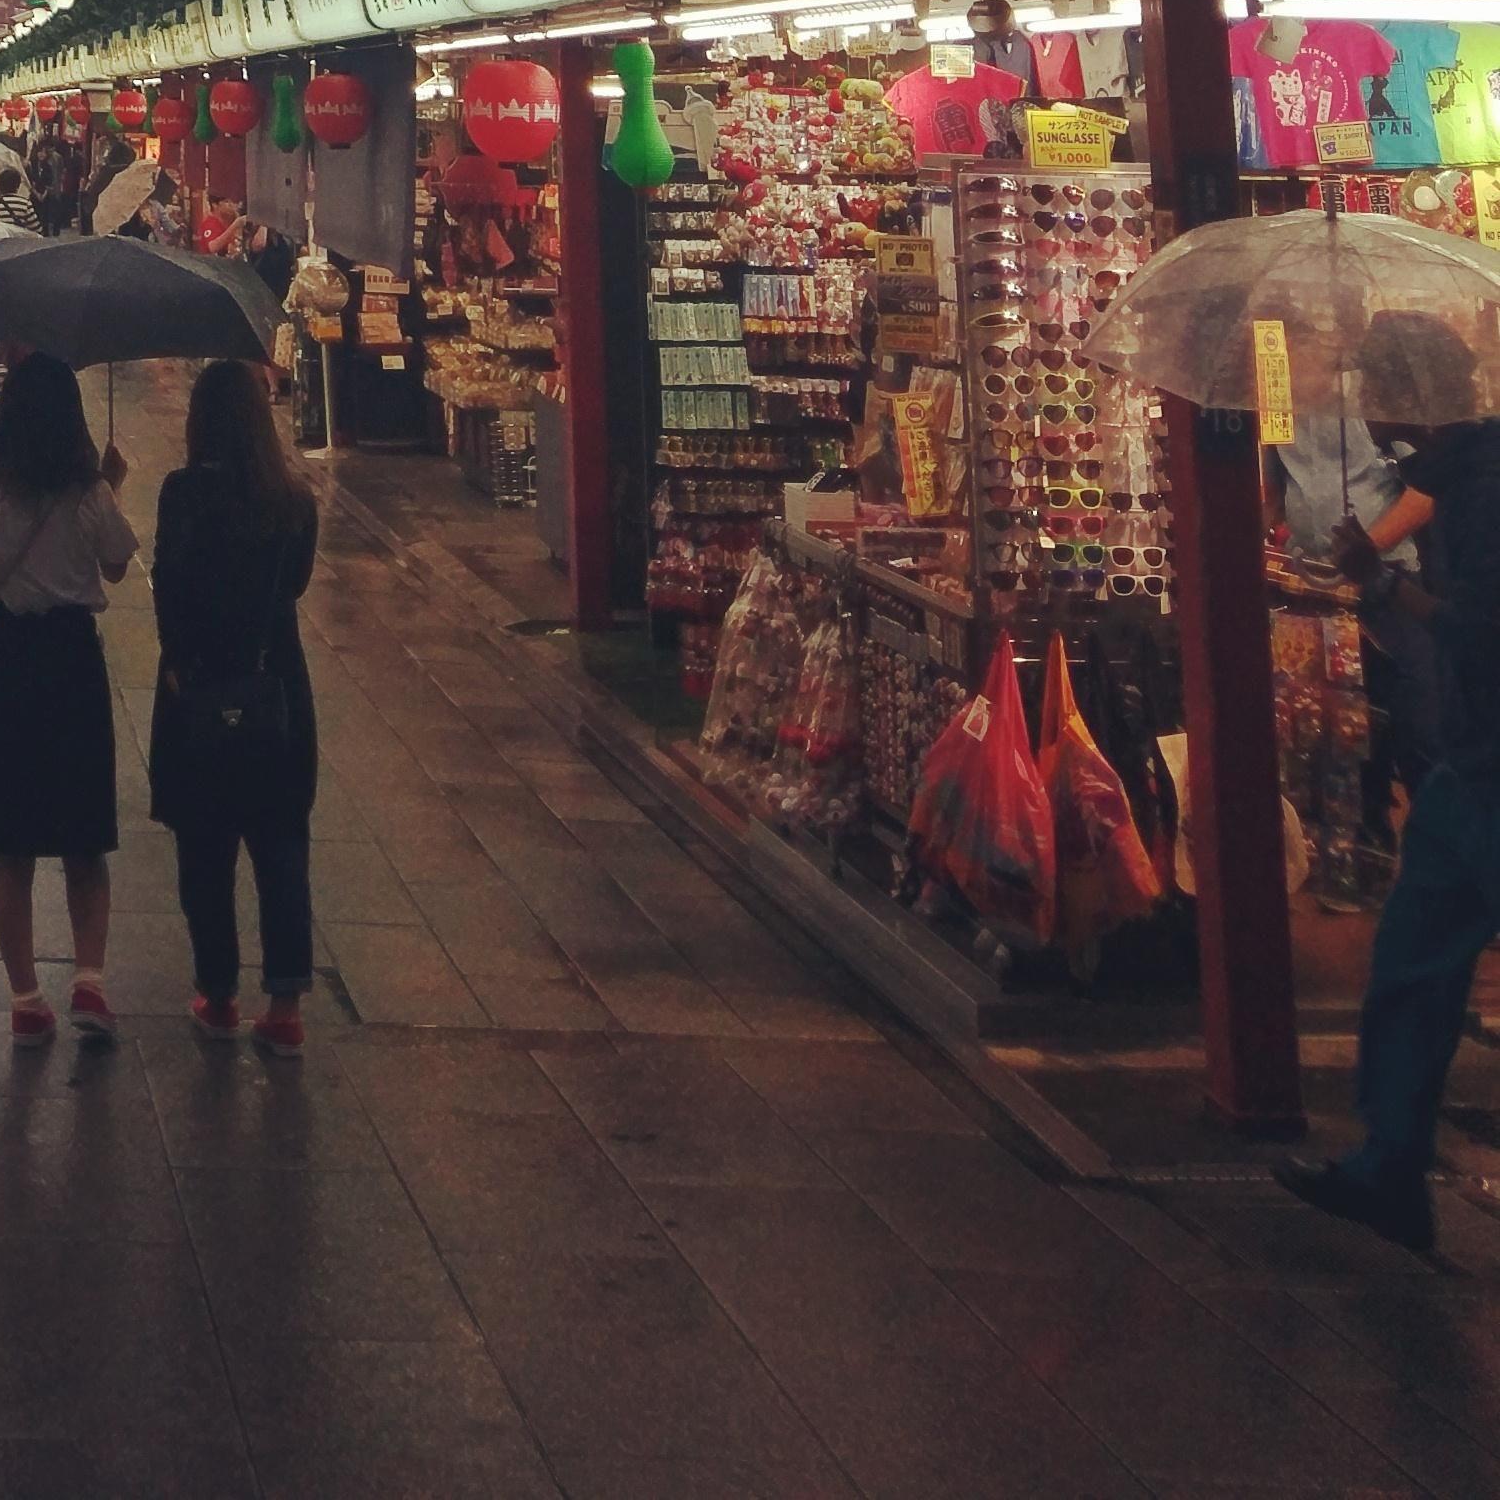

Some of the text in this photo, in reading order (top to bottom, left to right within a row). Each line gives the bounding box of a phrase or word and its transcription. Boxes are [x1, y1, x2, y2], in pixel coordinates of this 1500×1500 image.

[1036, 131, 1101, 145] SUNGLASSE
[1049, 152, 1093, 165] ¥1,000
[899, 243, 930, 252] PHOTO
